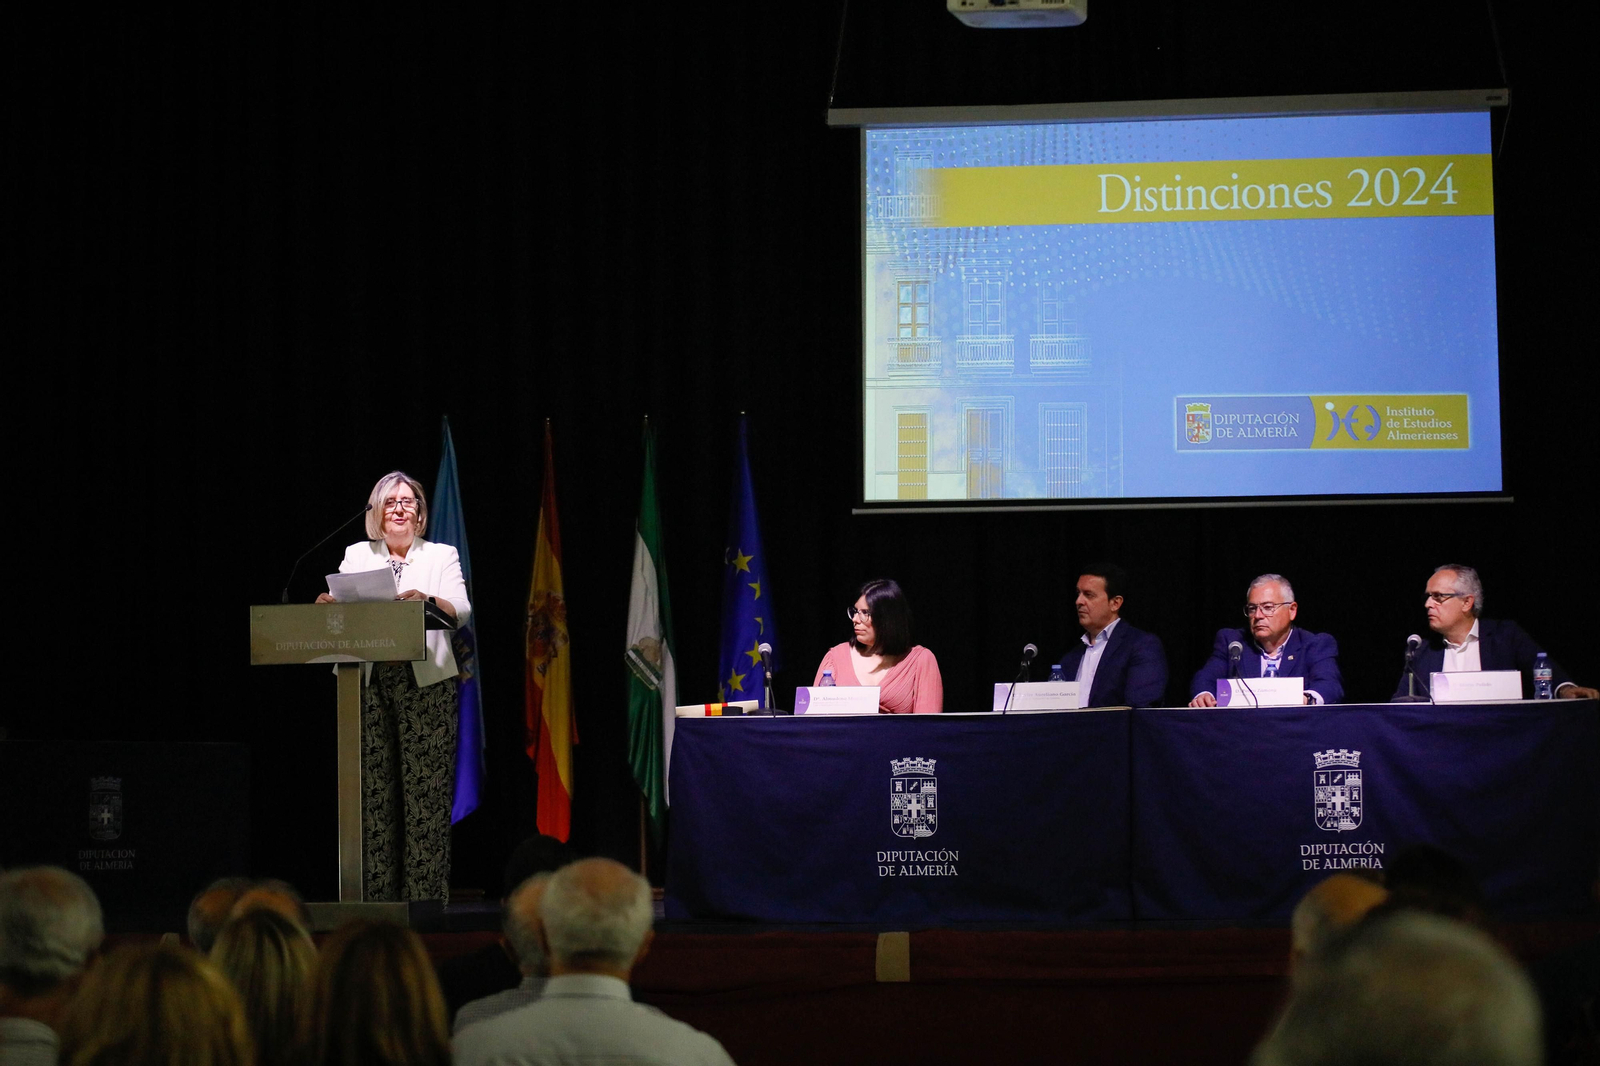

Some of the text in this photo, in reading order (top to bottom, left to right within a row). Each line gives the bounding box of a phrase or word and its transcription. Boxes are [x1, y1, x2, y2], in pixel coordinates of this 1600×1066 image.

[1097, 162, 1458, 213] Distinciones 2024
[1213, 411, 1300, 425] DIPUTACIÓN
[1386, 406, 1435, 417] Instituto
[1386, 418, 1452, 429] de Estudios
[1216, 425, 1299, 438] DE ALMERÍA
[1386, 430, 1459, 441] Almerienses
[275, 637, 397, 651] DIPUTACIÓN DE ALMERÍA
[876, 847, 959, 862] DIPUTACIÓN
[1300, 840, 1385, 856] DIPUTACIÓN
[79, 861, 92, 871] DE
[878, 862, 959, 877] DE ALMERÍA
[1302, 855, 1383, 870] DE ALMERÍA
